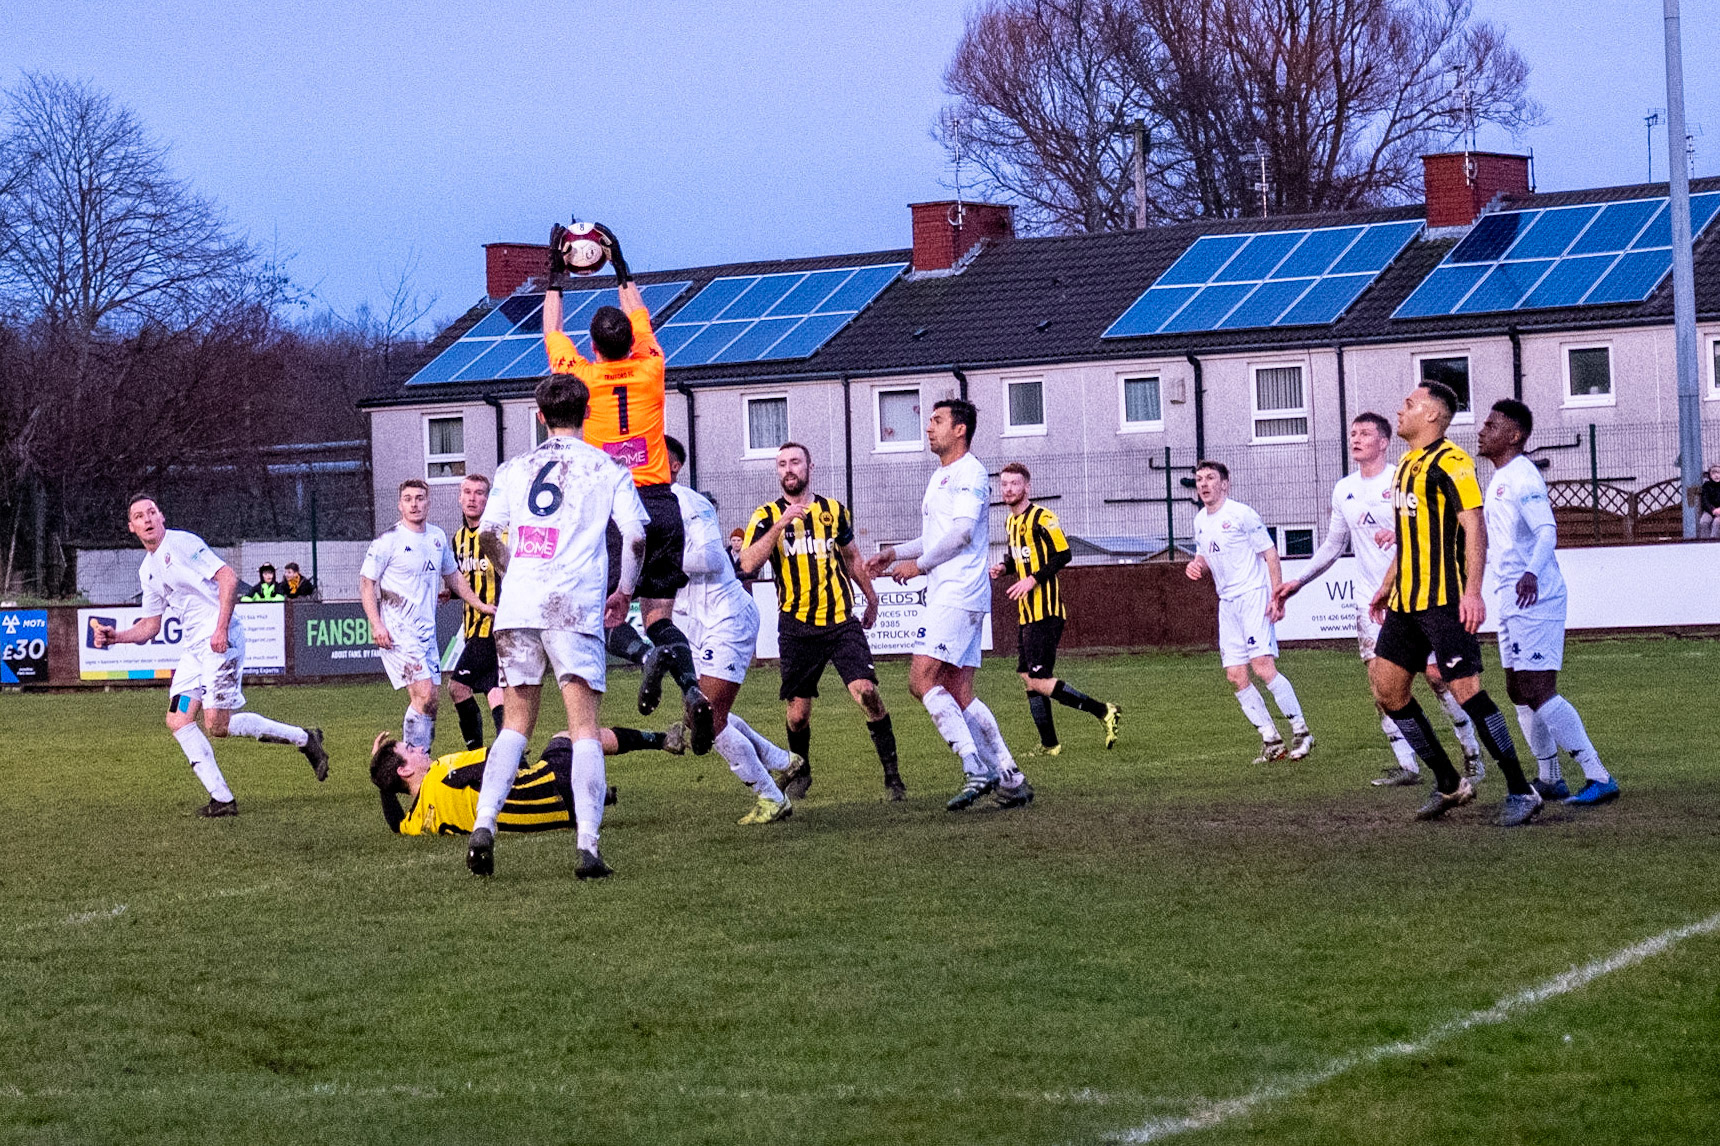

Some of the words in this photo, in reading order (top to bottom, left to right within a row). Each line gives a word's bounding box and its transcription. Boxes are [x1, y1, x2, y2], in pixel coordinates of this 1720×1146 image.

[612, 386, 629, 435] 1
[528, 461, 564, 517] 6
[903, 609, 918, 617] LTD
[23, 619, 45, 628] MOTs
[877, 630, 910, 639] TRUCK
[916, 627, 927, 638] 8
[2, 638, 45, 661] £30
[702, 649, 714, 660] 3
